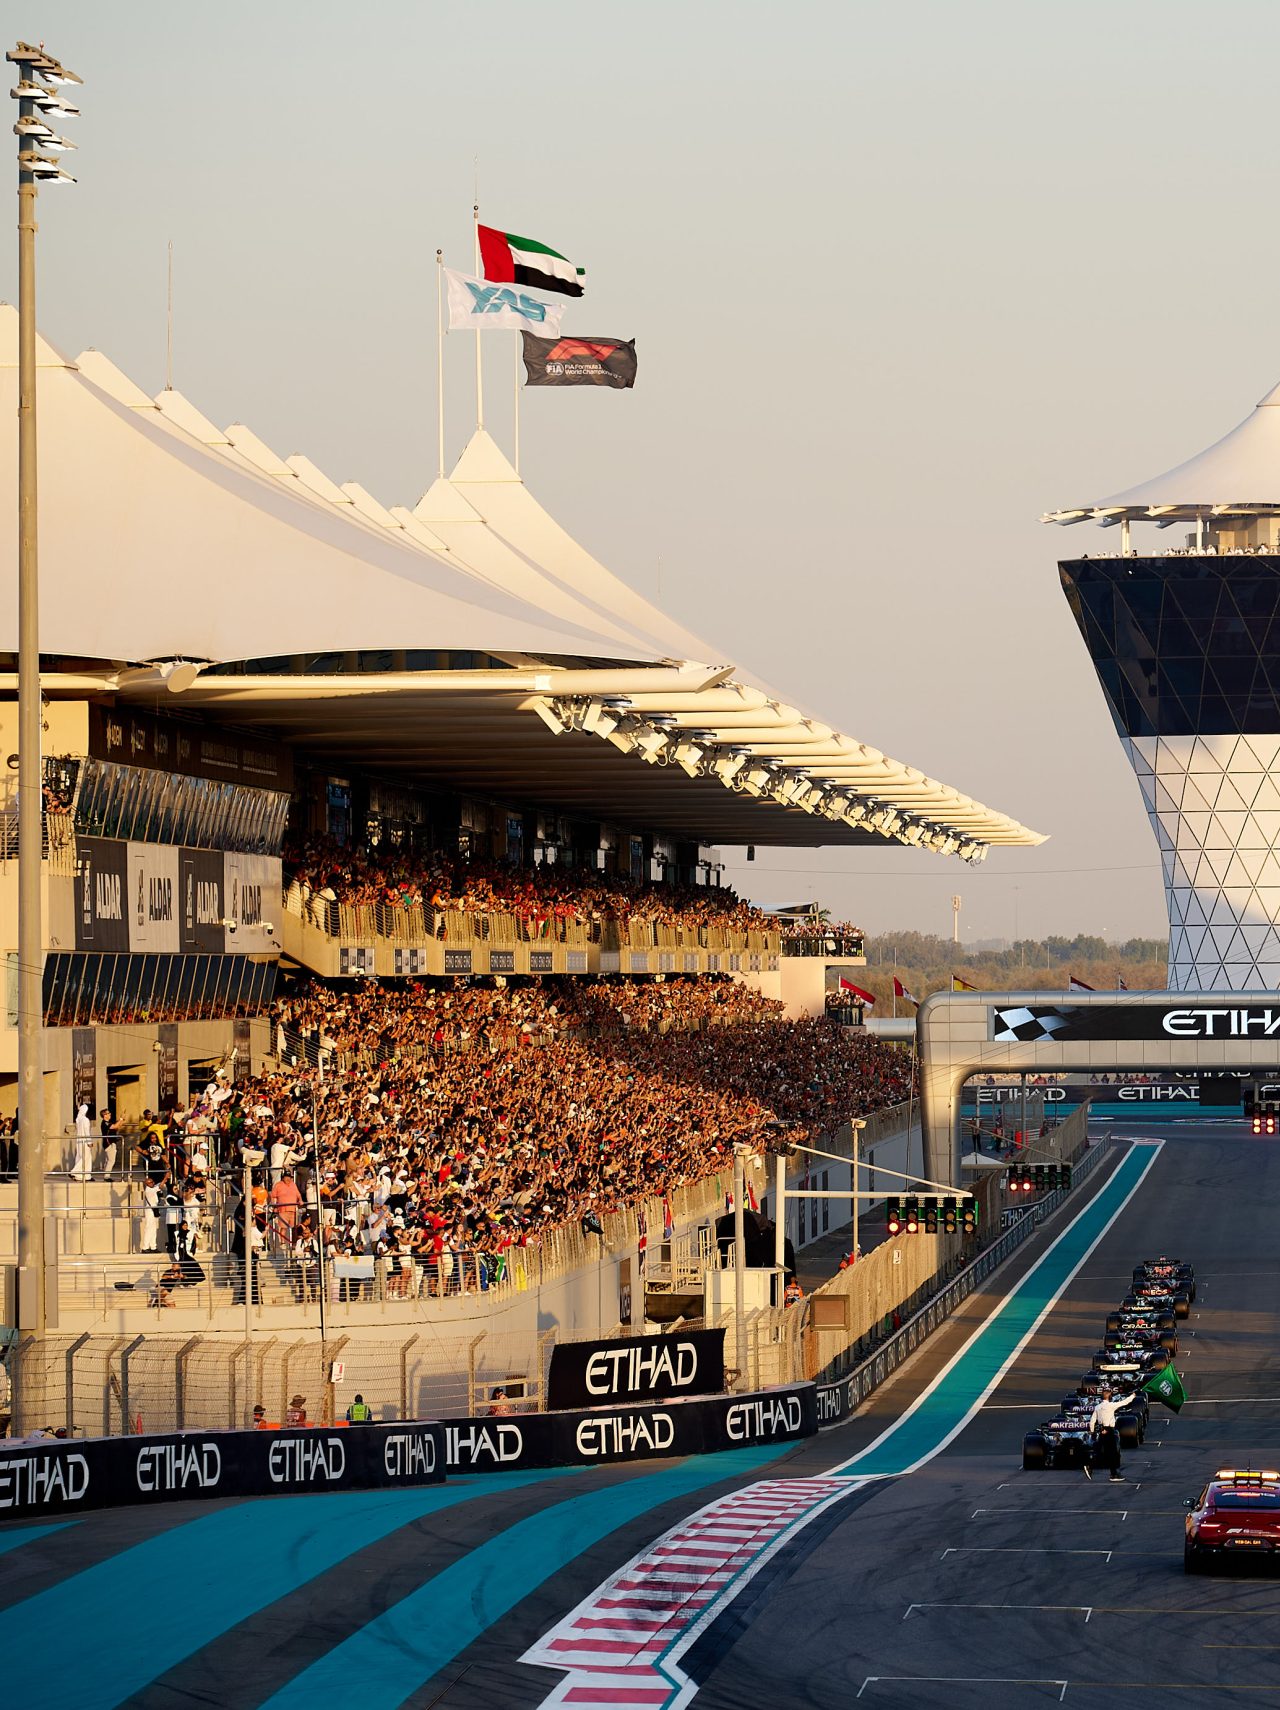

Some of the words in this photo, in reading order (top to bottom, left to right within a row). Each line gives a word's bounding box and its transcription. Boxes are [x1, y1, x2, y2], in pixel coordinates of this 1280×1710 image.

[465, 281, 547, 323] YAS
[546, 364, 562, 373] FIA
[96, 872, 122, 920] ALDAR
[149, 877, 172, 921] ALDAR
[197, 881, 219, 924] ALDAR
[242, 885, 262, 926] ALDAR
[585, 1342, 698, 1395] ETIHAD
[1159, 1381, 1172, 1396] FIA
[576, 1413, 675, 1456] ETIHAD
[726, 1396, 802, 1441] ETIHAD
[269, 1437, 346, 1483] ETIHAD
[384, 1432, 435, 1477] ETIHAD
[446, 1424, 523, 1465] IHAD
[0, 1453, 90, 1508] ETIHAD
[136, 1442, 221, 1492] ETIHAD
